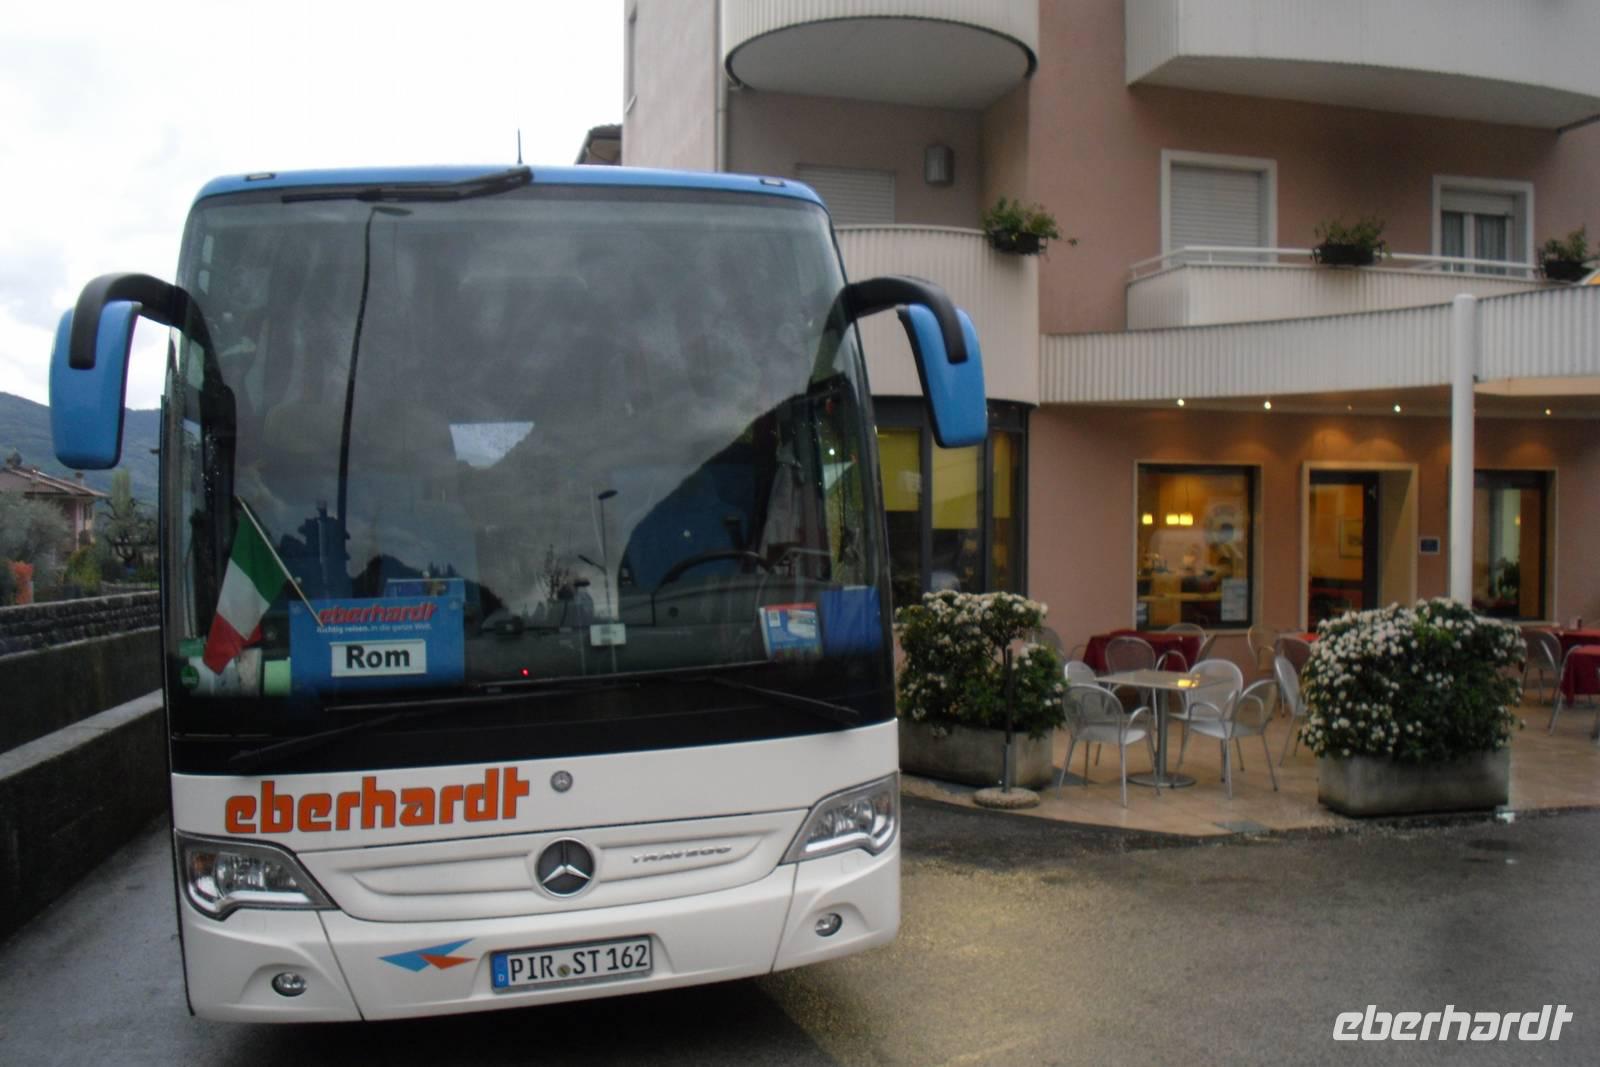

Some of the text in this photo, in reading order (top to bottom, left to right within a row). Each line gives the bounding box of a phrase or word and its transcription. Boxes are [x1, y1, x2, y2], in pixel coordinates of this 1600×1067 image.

[319, 602, 436, 624] eberhardt
[345, 645, 410, 669] Rom
[225, 767, 529, 833] eberhardt
[510, 955, 554, 981] PIR
[573, 949, 601, 974] ST
[606, 944, 648, 970] 162
